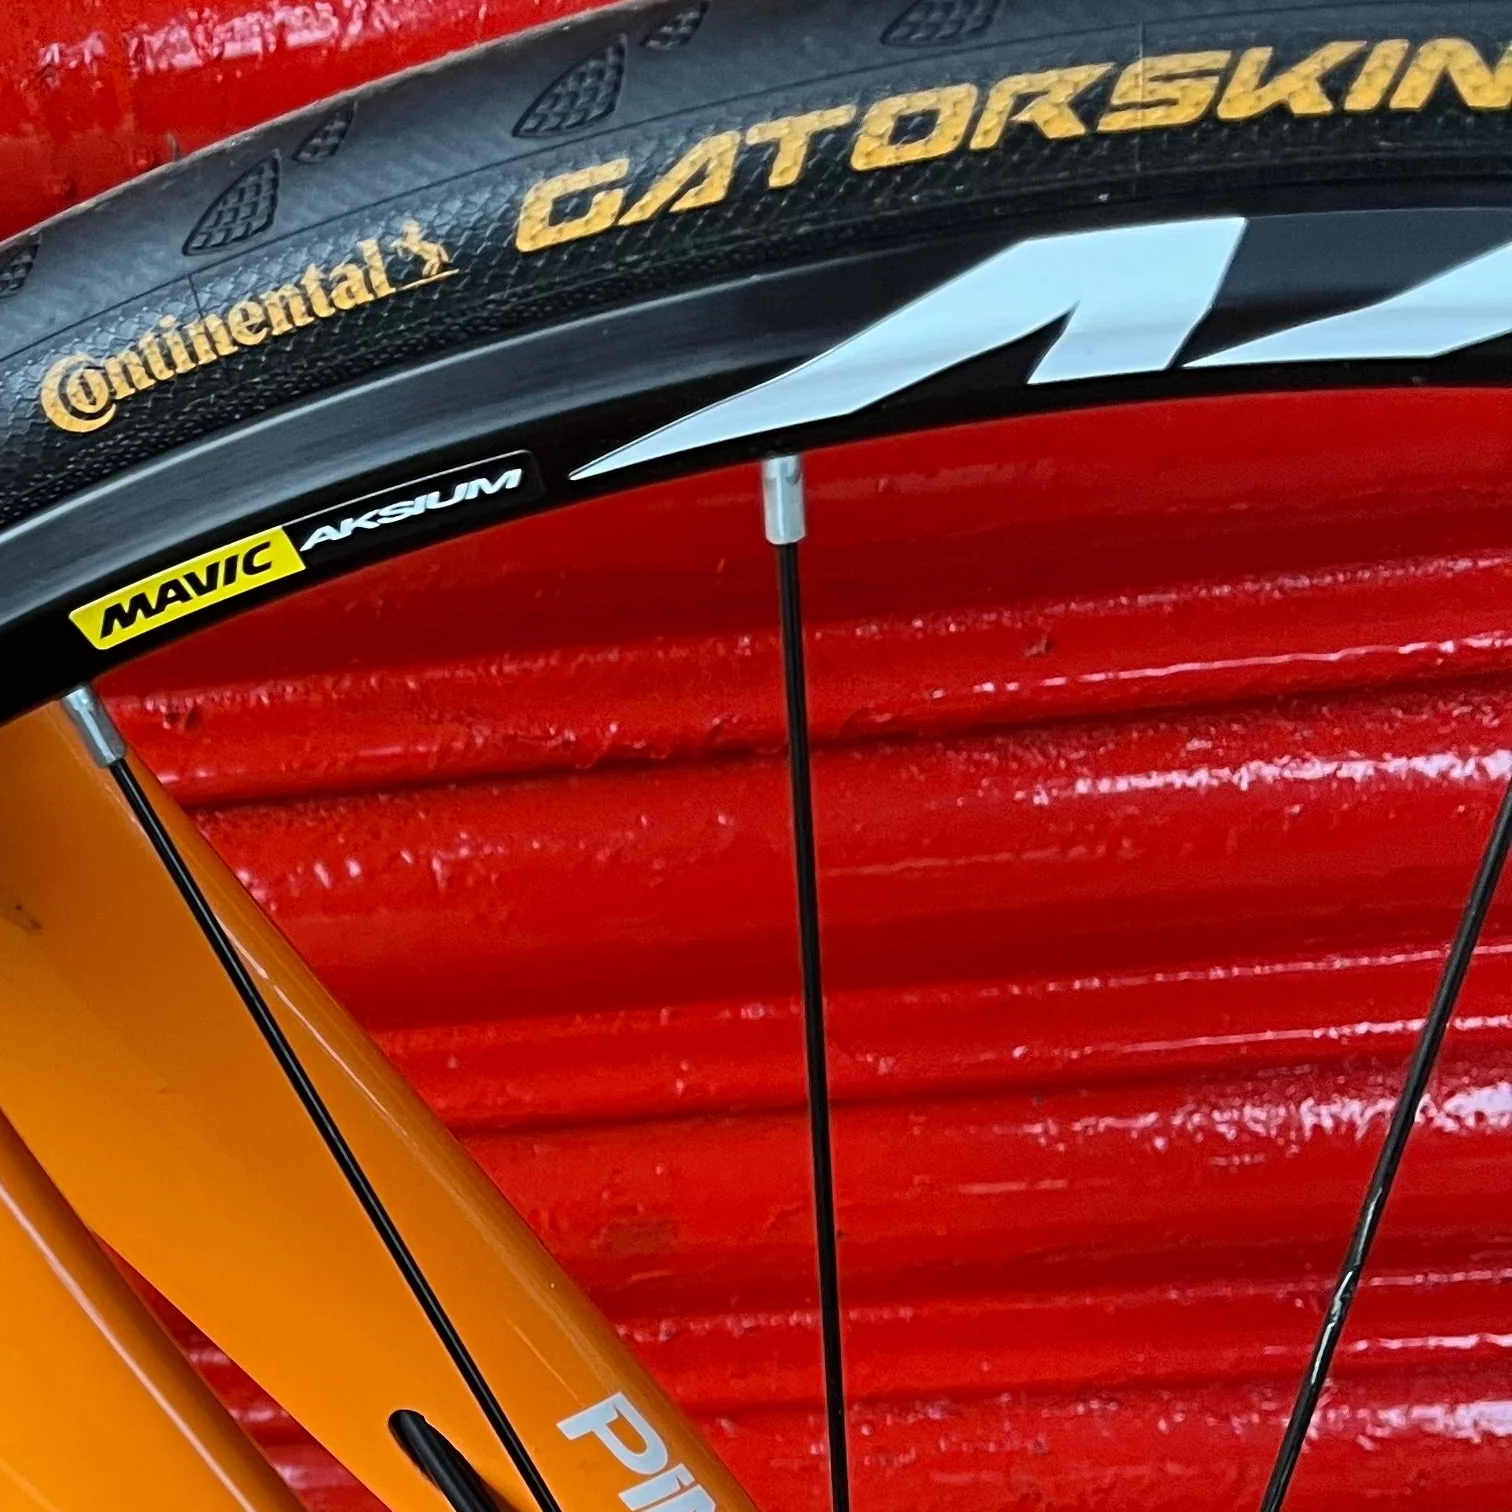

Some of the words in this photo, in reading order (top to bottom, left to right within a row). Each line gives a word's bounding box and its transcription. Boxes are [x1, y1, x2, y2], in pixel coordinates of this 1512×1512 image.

[40, 238, 396, 433] Continental
[99, 540, 273, 640] MAVIC
[299, 468, 522, 552] AKSIUM
